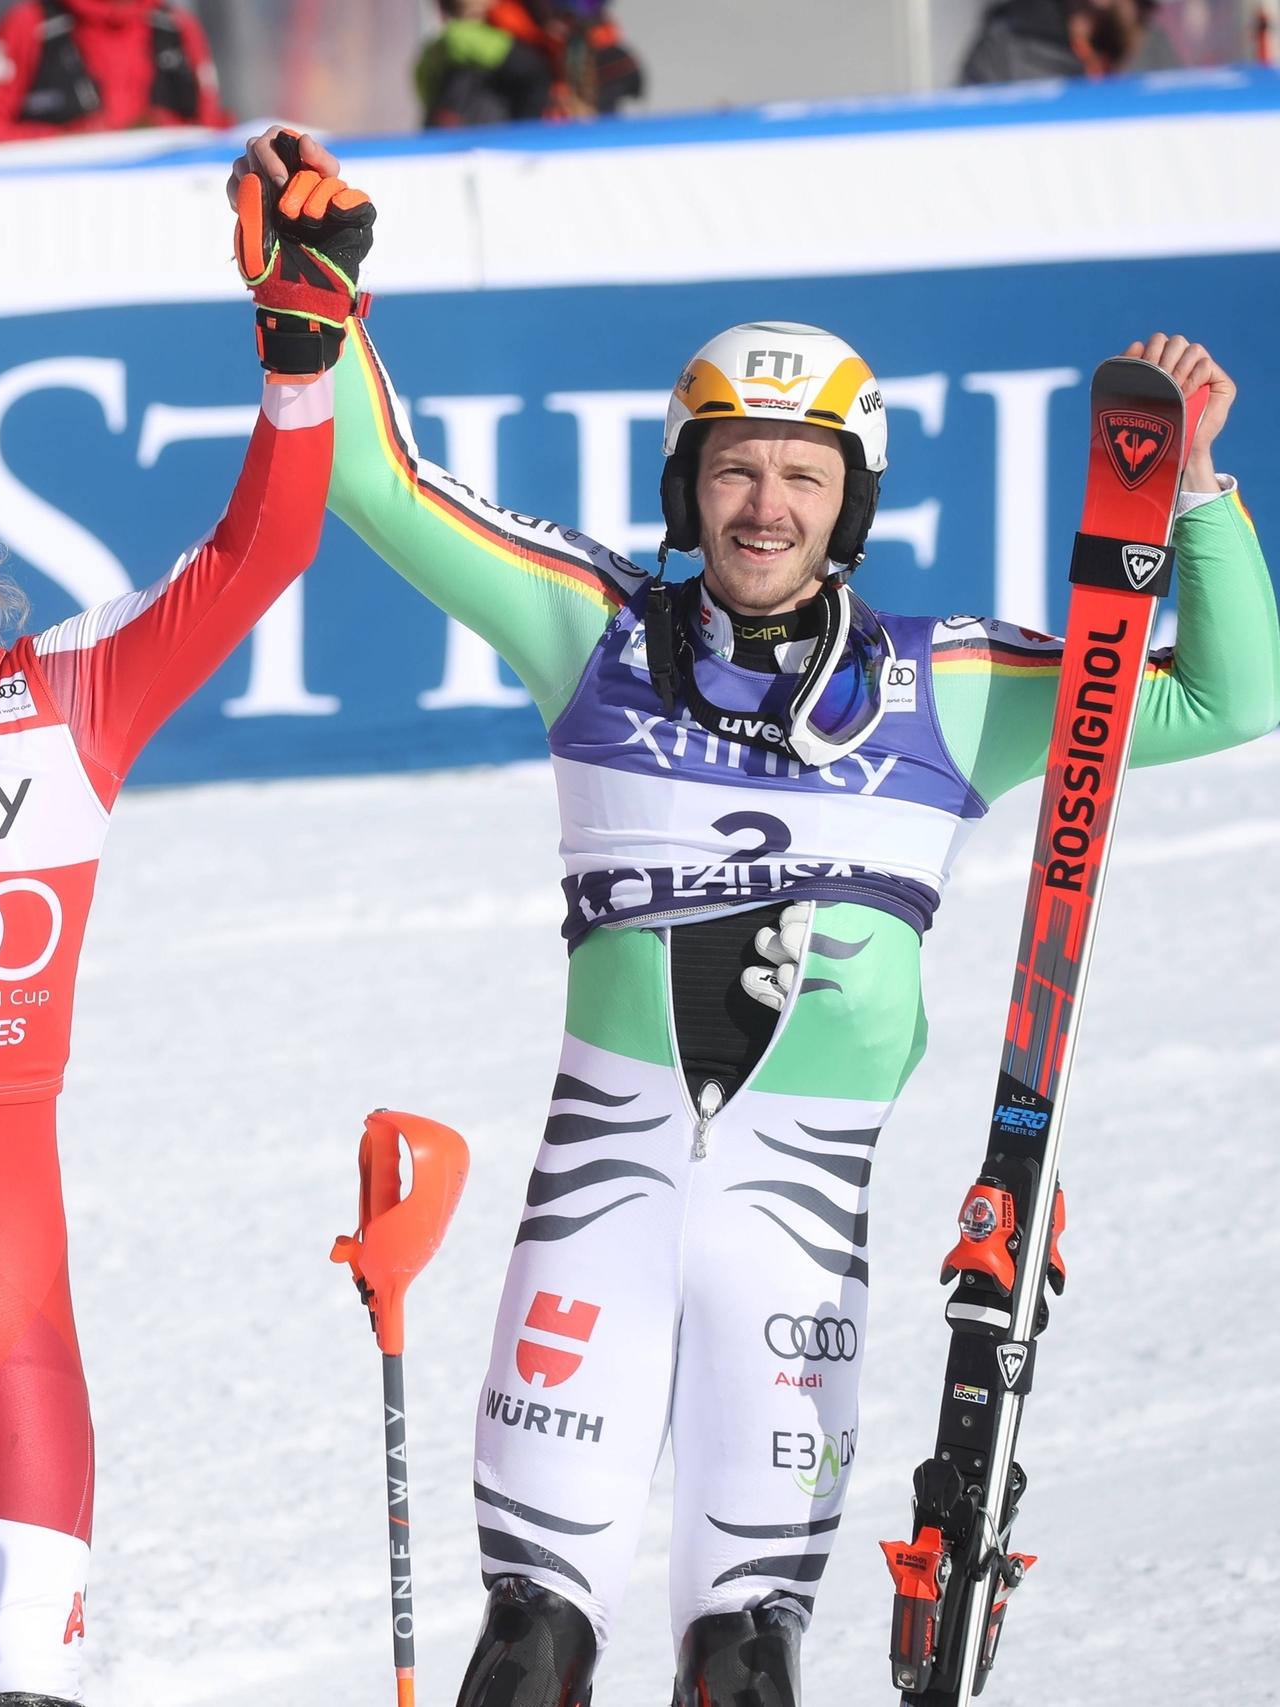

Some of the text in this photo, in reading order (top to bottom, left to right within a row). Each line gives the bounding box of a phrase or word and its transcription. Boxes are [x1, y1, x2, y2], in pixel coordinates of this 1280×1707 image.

[746, 350, 804, 377] FTI
[859, 389, 884, 415] uve
[1110, 416, 1164, 435] ROSSIGNOL
[1127, 548, 1159, 560] ROSSIGNOL
[1045, 619, 1129, 892] ROSSIGNOL
[9, 988, 50, 1007] Cup
[993, 1105, 1049, 1130] HERO
[999, 1125, 1028, 1135] ATHLETE
[774, 1371, 824, 1389] Audi
[954, 1391, 978, 1401] LOOK
[485, 1387, 604, 1443] WÜRTH
